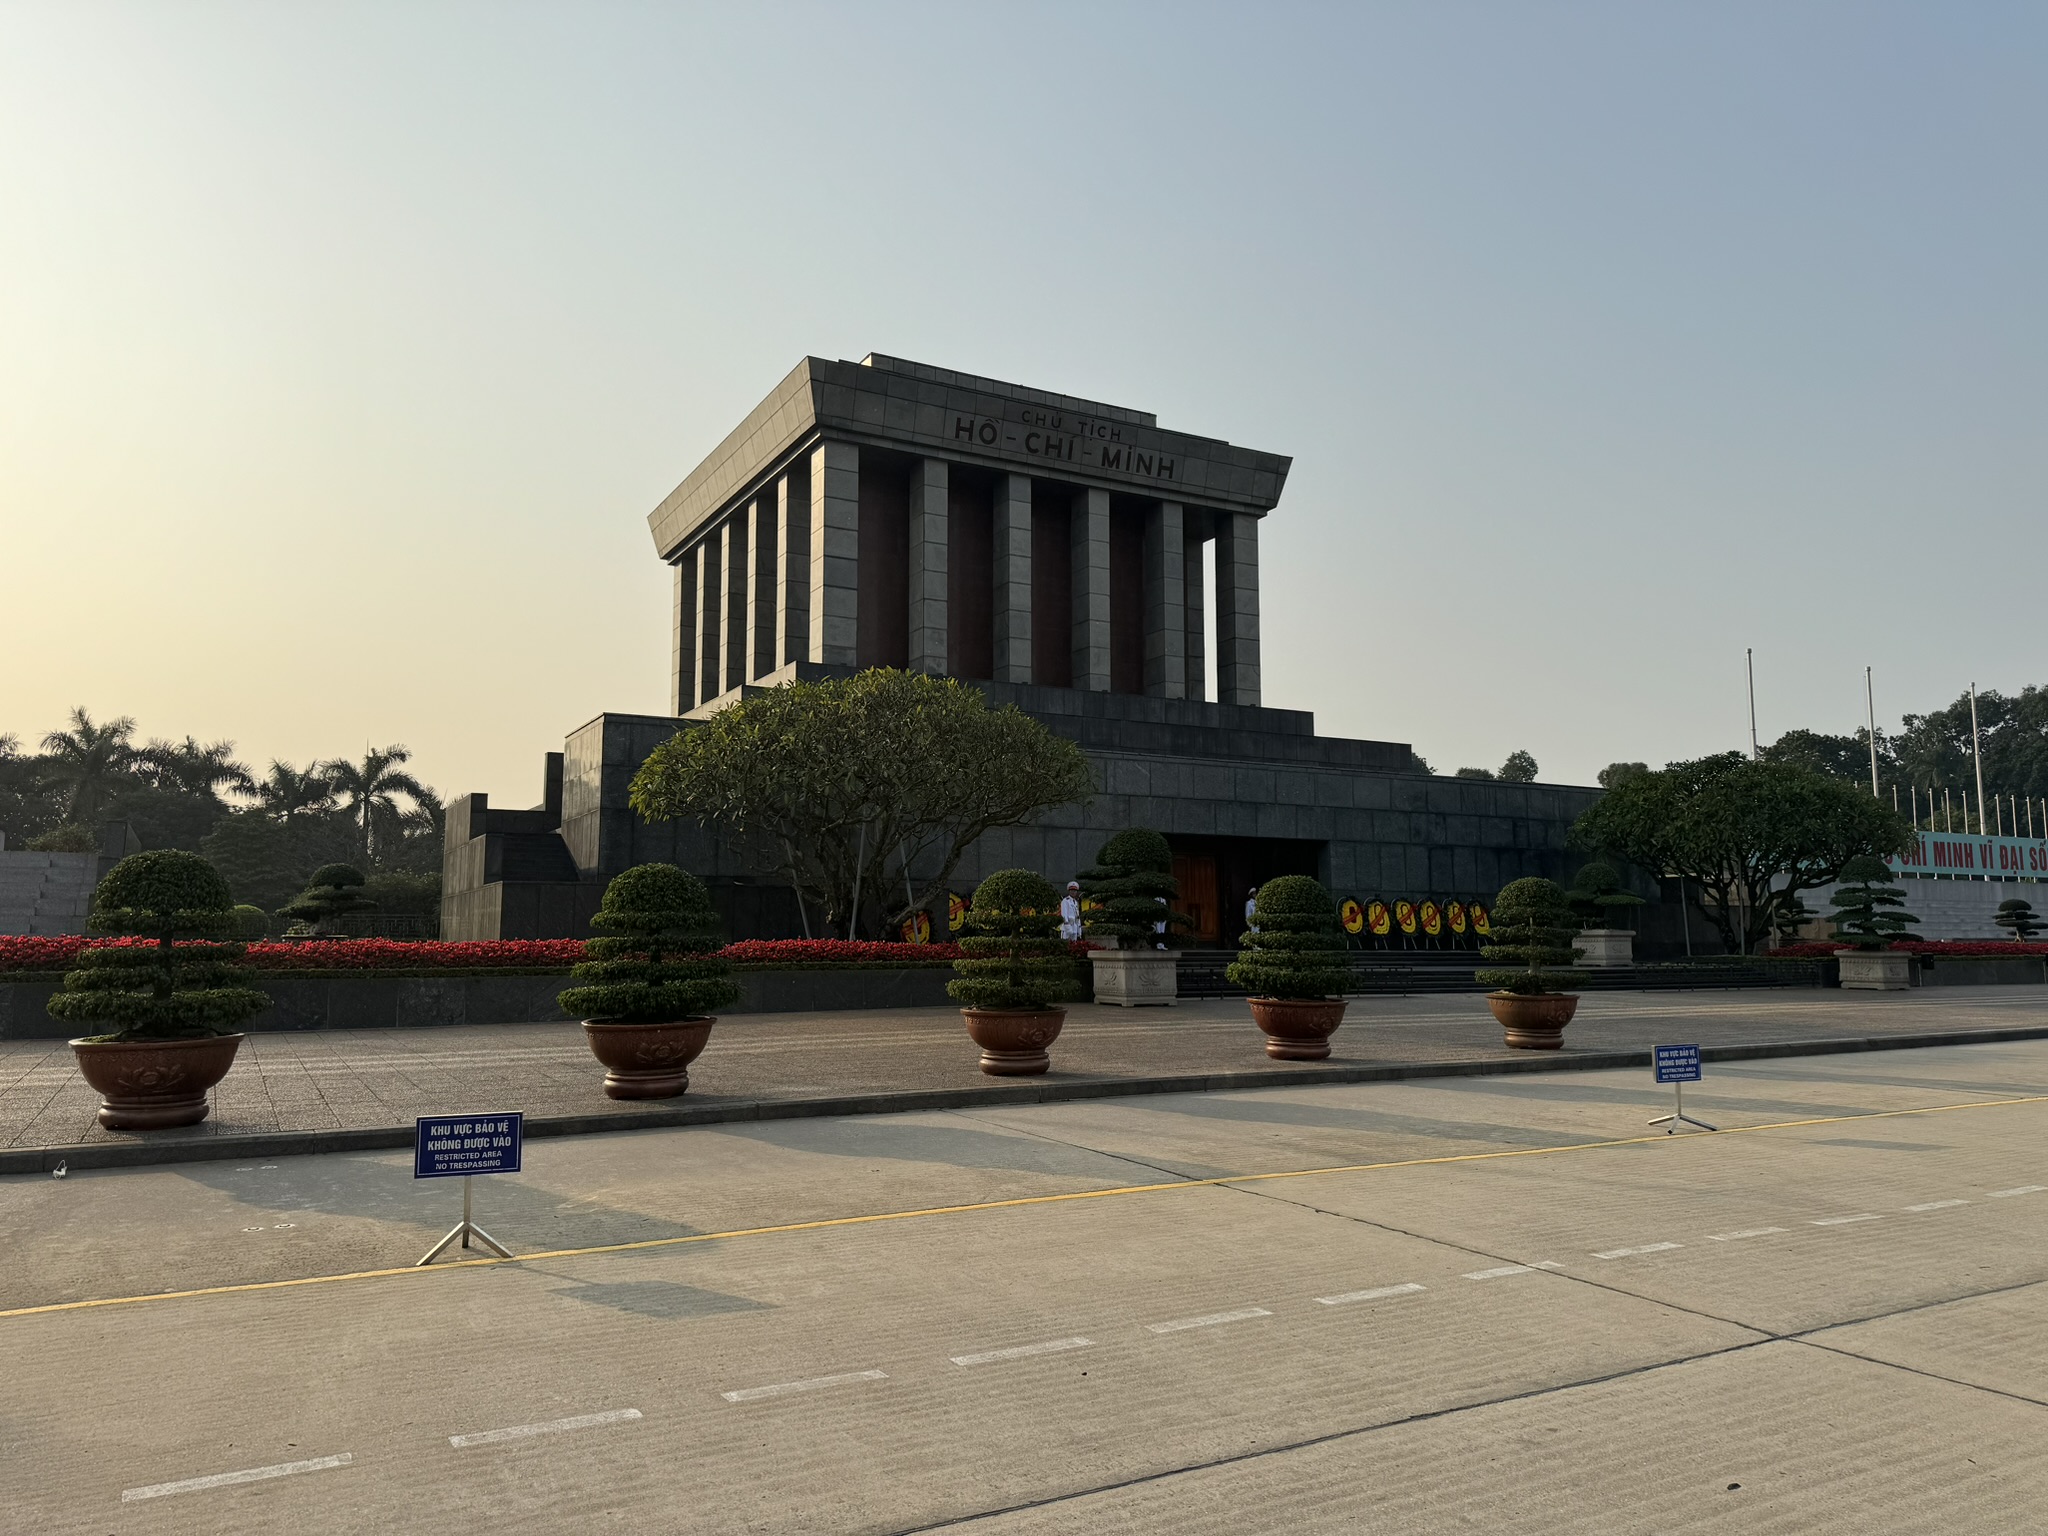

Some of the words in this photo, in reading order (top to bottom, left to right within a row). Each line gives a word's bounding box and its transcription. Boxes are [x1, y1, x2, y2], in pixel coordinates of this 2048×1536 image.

[1021, 410, 1062, 429] CHỦ
[1078, 419, 1121, 441] TỊCH
[954, 417, 1000, 445] HỒ
[1025, 432, 1077, 461] CHÍ
[1101, 445, 1175, 479] MINH
[1933, 840, 1974, 868] MINH
[1979, 839, 1994, 869] VĨ
[1999, 844, 2025, 875] ĐẠI
[430, 1125, 451, 1136] KHU
[453, 1123, 473, 1137] VỰC
[475, 1119, 495, 1134] BẢO
[497, 1119, 510, 1134] VỆ
[427, 1137, 461, 1151] KHÔNG
[464, 1137, 490, 1151] ĐƯỢC
[492, 1134, 512, 1147] VÀO
[434, 1152, 480, 1161] RESTRICTED
[449, 1159, 501, 1169] TRESPASSING
